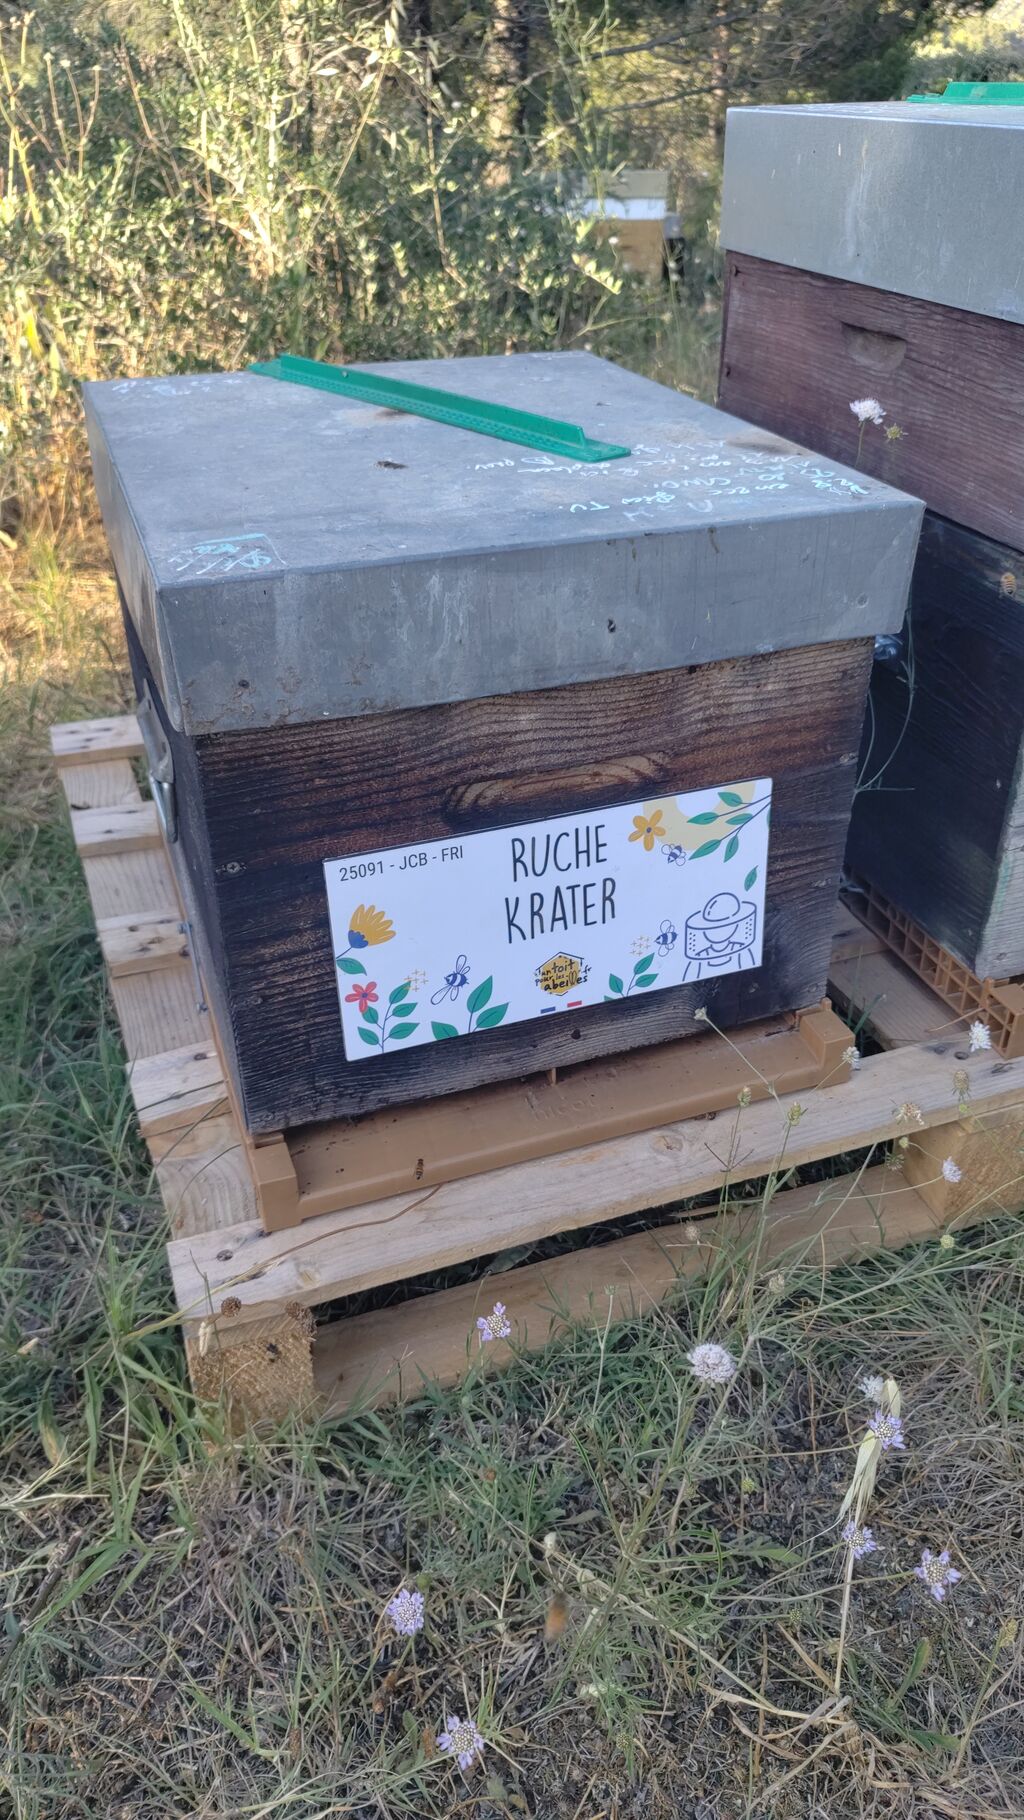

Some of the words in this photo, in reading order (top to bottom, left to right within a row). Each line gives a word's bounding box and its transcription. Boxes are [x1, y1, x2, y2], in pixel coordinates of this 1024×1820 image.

[338, 861, 384, 882] 25091
[399, 852, 428, 870] JCB
[441, 845, 464, 862] FRI
[511, 824, 608, 883] RUCHE
[505, 877, 617, 944] KRATER
[534, 976, 554, 987] pour
[551, 958, 575, 973] toit
